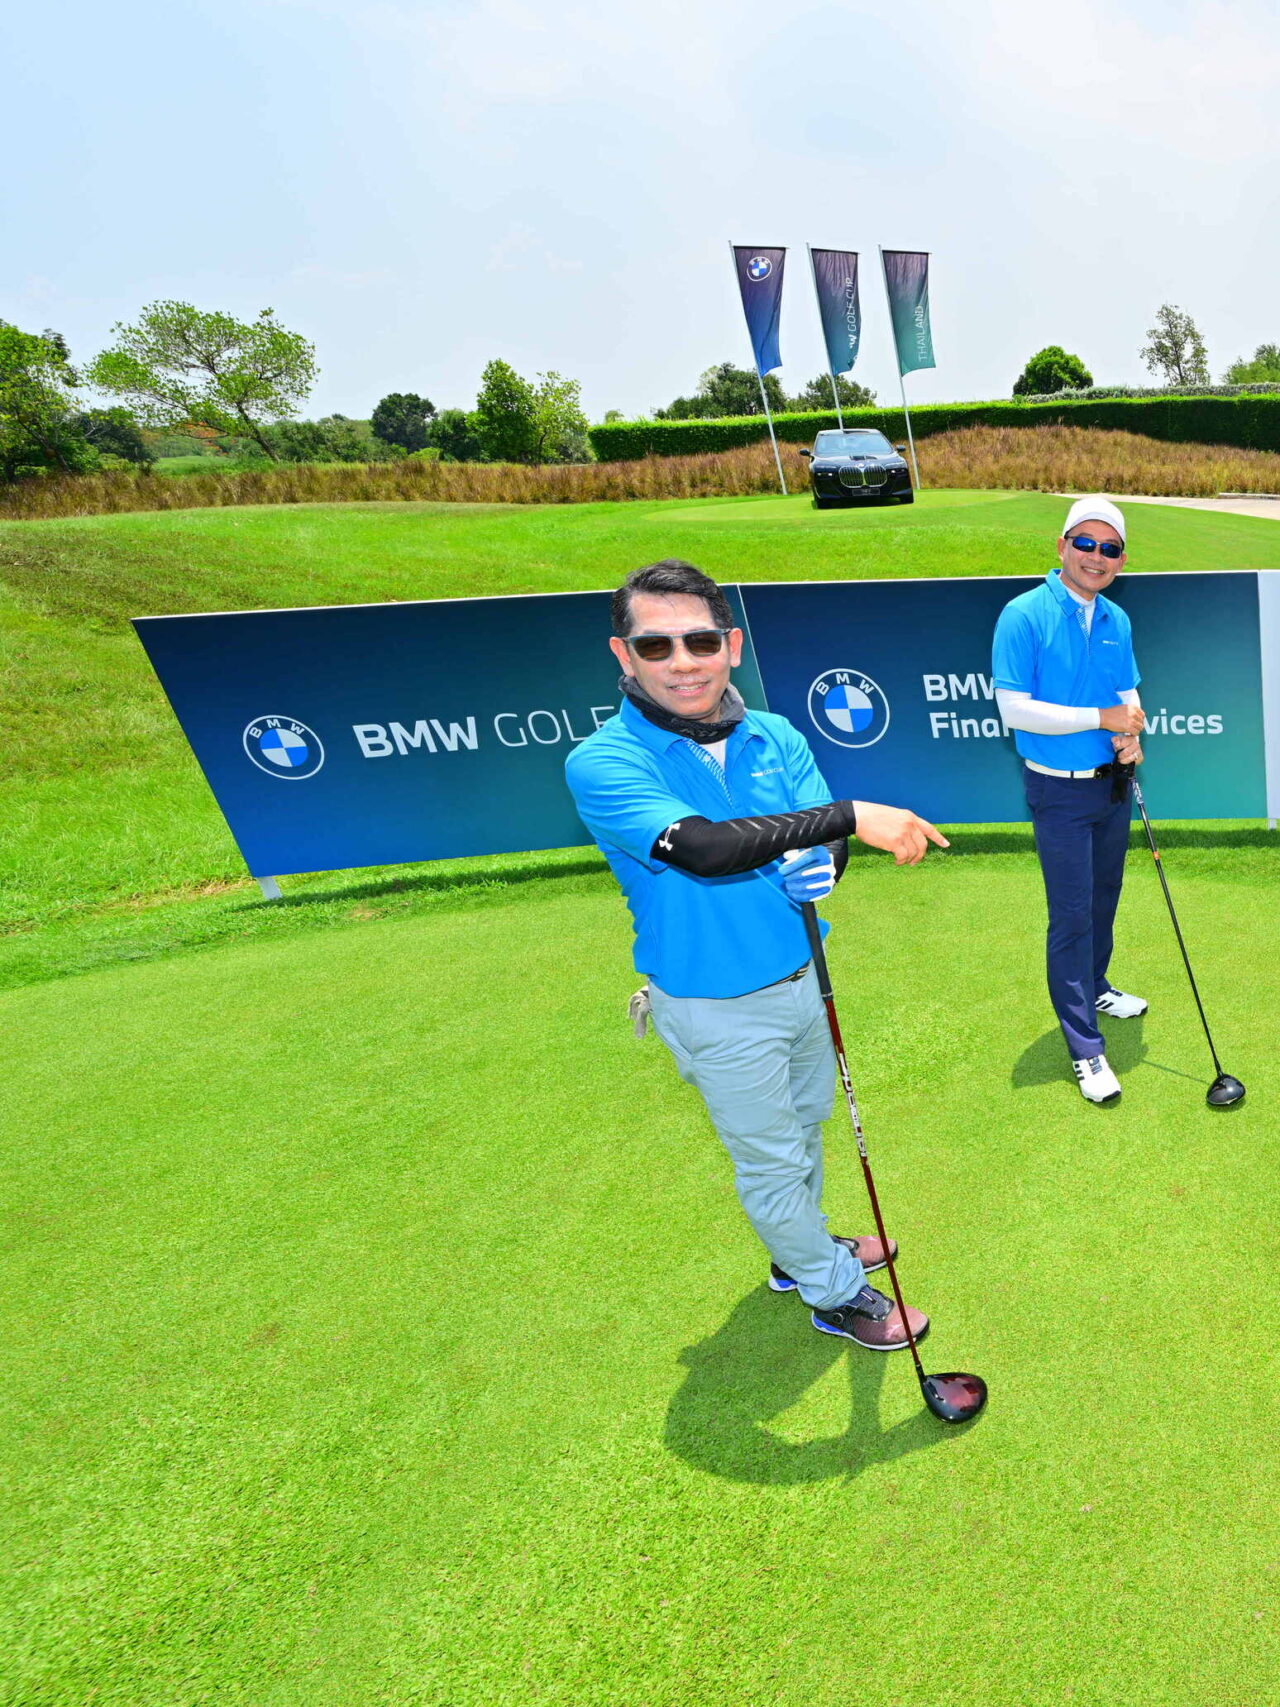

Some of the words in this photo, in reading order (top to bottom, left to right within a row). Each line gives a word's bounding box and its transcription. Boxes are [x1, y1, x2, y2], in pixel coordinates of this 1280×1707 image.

[914, 305, 928, 363] THAILAND
[817, 673, 875, 697] BMW
[248, 718, 305, 739] BMW
[352, 715, 479, 759] BMW
[494, 705, 615, 747] GOLF
